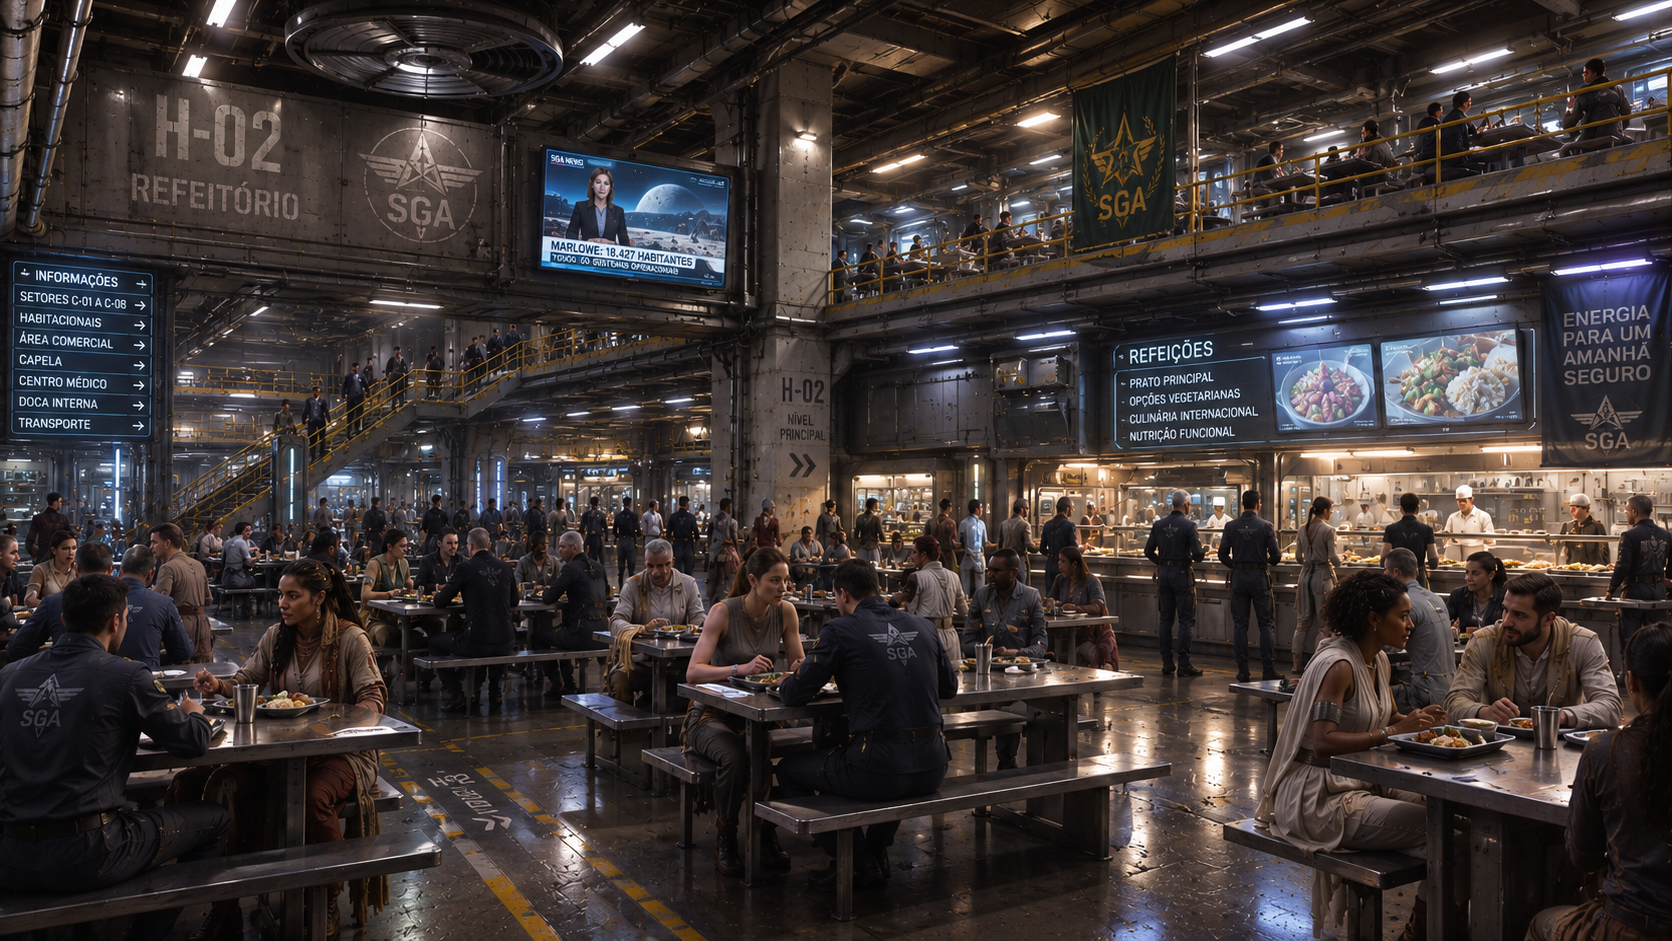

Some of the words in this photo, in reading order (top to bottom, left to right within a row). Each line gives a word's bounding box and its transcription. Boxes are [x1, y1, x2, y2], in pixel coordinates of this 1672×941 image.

[155, 94, 282, 173] H-02
[131, 172, 299, 220] REFEITÓRIO
[1098, 186, 1147, 221] SGA
[387, 193, 456, 230] SGA
[551, 241, 603, 256] MARLOWE:
[605, 247, 635, 260] 18.427
[637, 251, 693, 267] HABITANTES
[35, 269, 119, 288] INFORMAÇÕES
[20, 291, 69, 305] SETORES
[94, 297, 103, 307] A
[104, 298, 127, 309] C-08
[19, 312, 102, 328] HABITACIONAIS
[1563, 304, 1651, 328] ENERGIA
[19, 330, 49, 345] ÁREA
[52, 335, 114, 349] COMERCIAL
[1563, 327, 1614, 347] PARA
[1620, 324, 1651, 342] UM
[19, 354, 63, 367] CAPELA
[1129, 339, 1214, 365] REFEIÇÕES
[1563, 341, 1651, 366] AMANHÃ
[19, 375, 63, 388] CENTRO
[66, 376, 108, 390] MÉDICO
[1129, 376, 1161, 389] PRATO
[1163, 371, 1215, 386] PRINCIPAL
[1563, 364, 1652, 386] SEGURO
[781, 377, 825, 404] H-02
[1168, 387, 1241, 404] VEGETARIANAS
[19, 396, 49, 408] DOCA
[52, 397, 99, 410] INTERNA
[18, 417, 91, 430] TRANSPORTE
[787, 411, 815, 427] NÍVEL
[1129, 409, 1178, 425] CULINÁRIA
[1180, 406, 1259, 421] INTERNACIONAL
[780, 428, 826, 442] PRINCIPAL
[1179, 426, 1236, 440] FUNCIONAL
[1584, 431, 1631, 451] SGA
[886, 646, 918, 660] SGA
[20, 709, 61, 728] SGA
